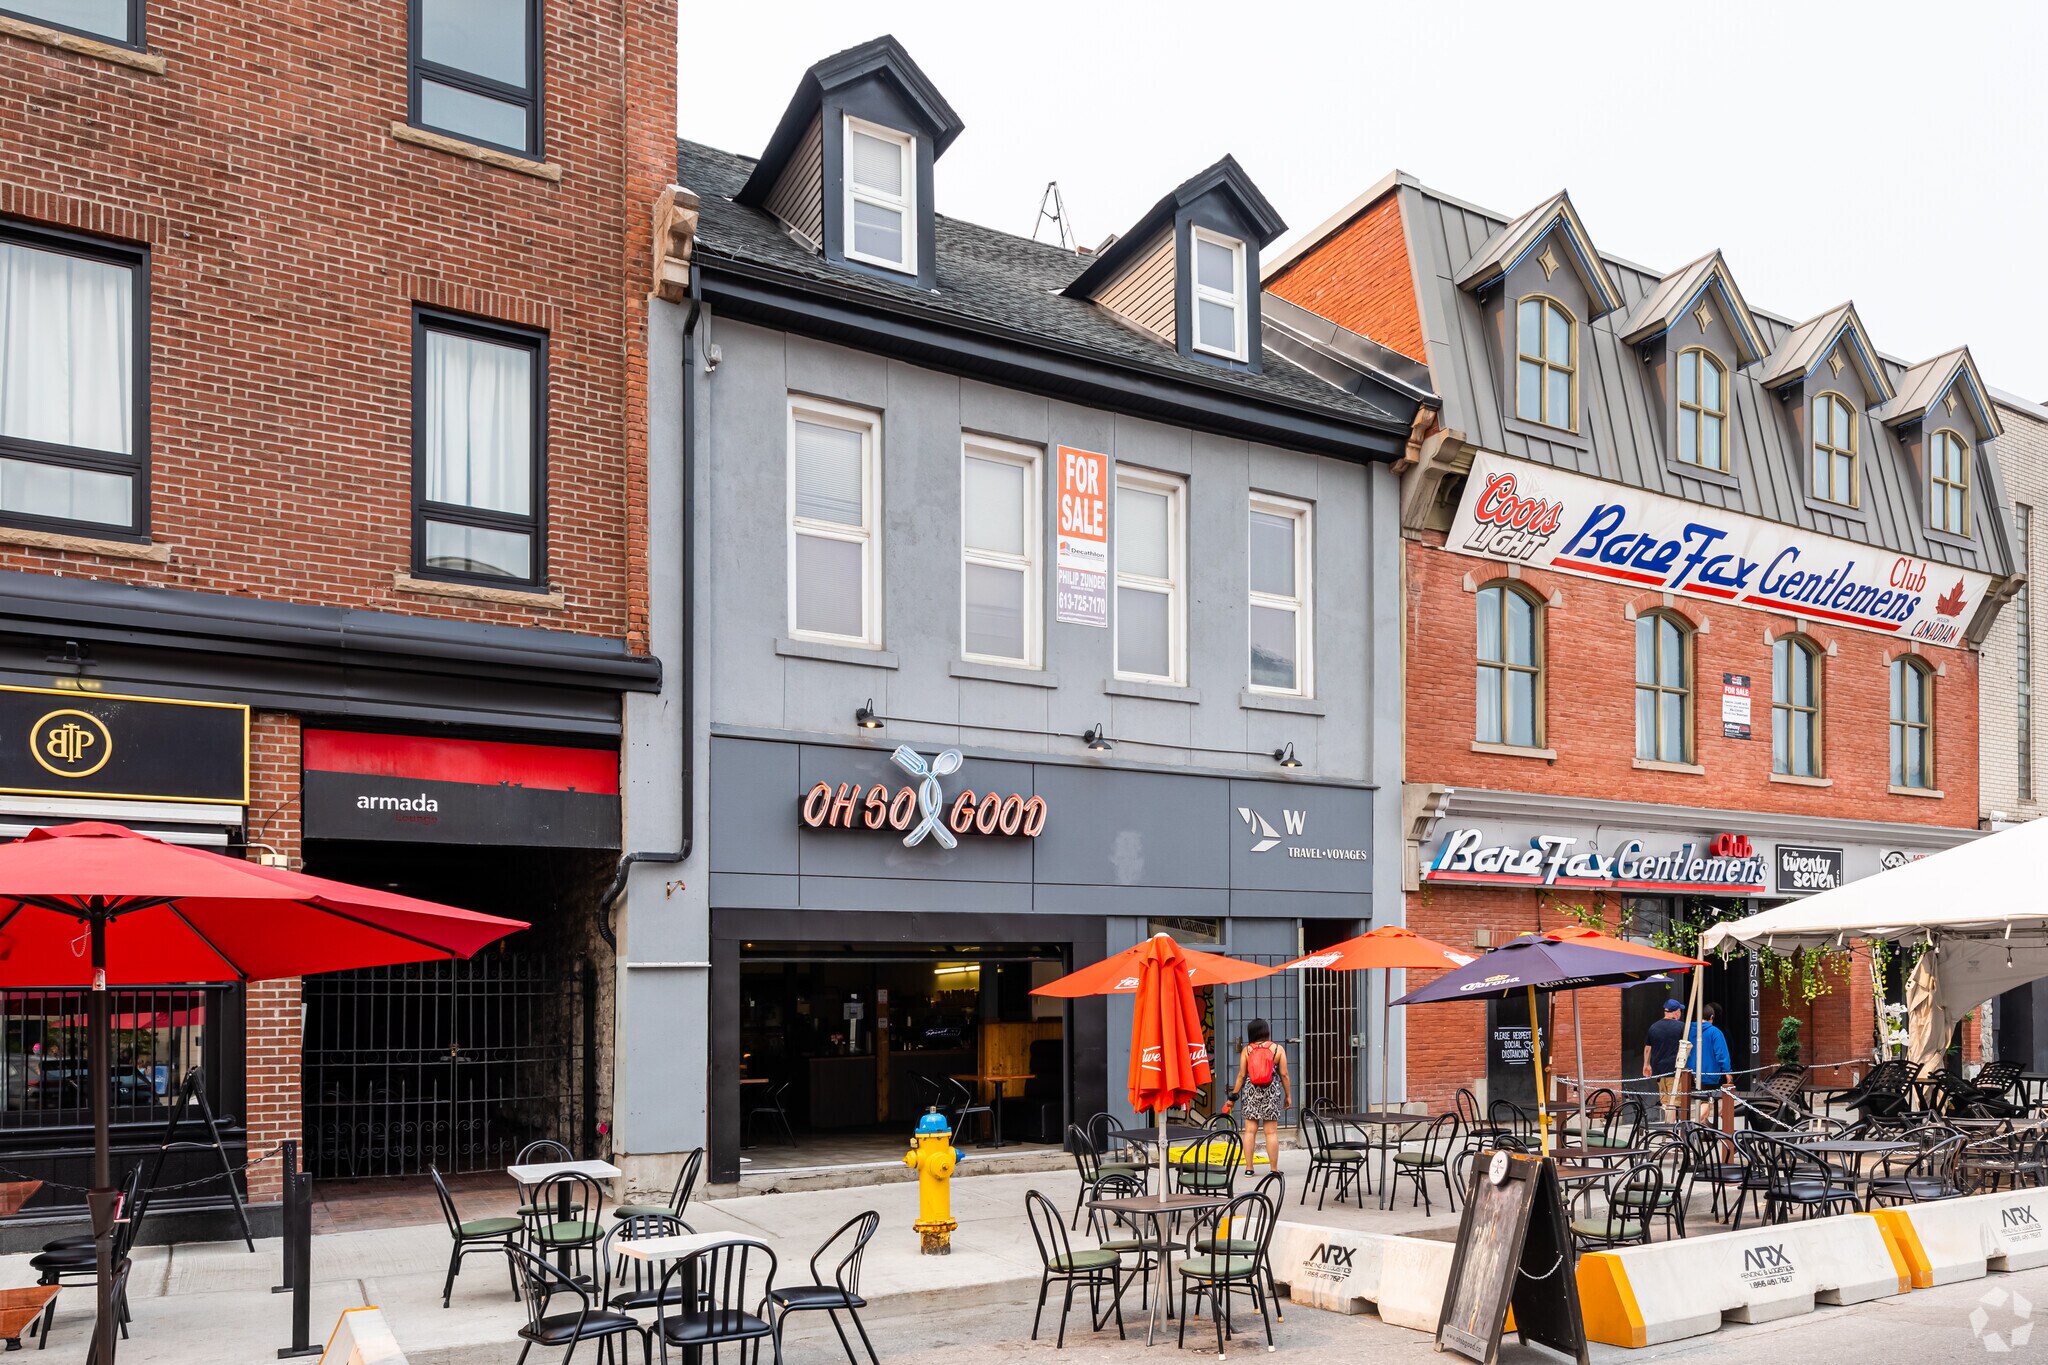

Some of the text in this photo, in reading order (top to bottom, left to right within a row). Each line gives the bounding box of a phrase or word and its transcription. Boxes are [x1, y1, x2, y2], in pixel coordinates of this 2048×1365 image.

[1066, 453, 1099, 496] FOR
[1062, 494, 1104, 537] SALE
[1475, 472, 1563, 536] Coors
[1071, 547, 1105, 558] Decathlon
[1463, 522, 1550, 561] LIGHT
[1058, 569, 1106, 590] PHILIP ZUNDER
[1758, 546, 1921, 622] Gentlemens
[1889, 556, 1928, 594] Club
[1058, 591, 1106, 615] 613-725-7170
[1910, 619, 1960, 643] CANADIAN
[1724, 686, 1749, 697] FOR SALE
[357, 793, 438, 812] armada
[803, 780, 1047, 837] OH SO GOOD
[1282, 809, 1307, 835] W
[1710, 832, 1754, 859] Club
[1613, 839, 1770, 884] Gentlemen's
[1782, 852, 1831, 876] twenty
[1793, 871, 1836, 888] seven
[1459, 976, 1521, 991] Corona
[1494, 1031, 1532, 1040] PLEASE RESPECT
[1503, 1040, 1522, 1049] SOCIAL
[1501, 1049, 1529, 1059] DISTANCING
[2001, 1205, 2039, 1228] ARX
[1309, 1243, 1358, 1268] ARX
[1744, 1243, 1791, 1271] ARX
